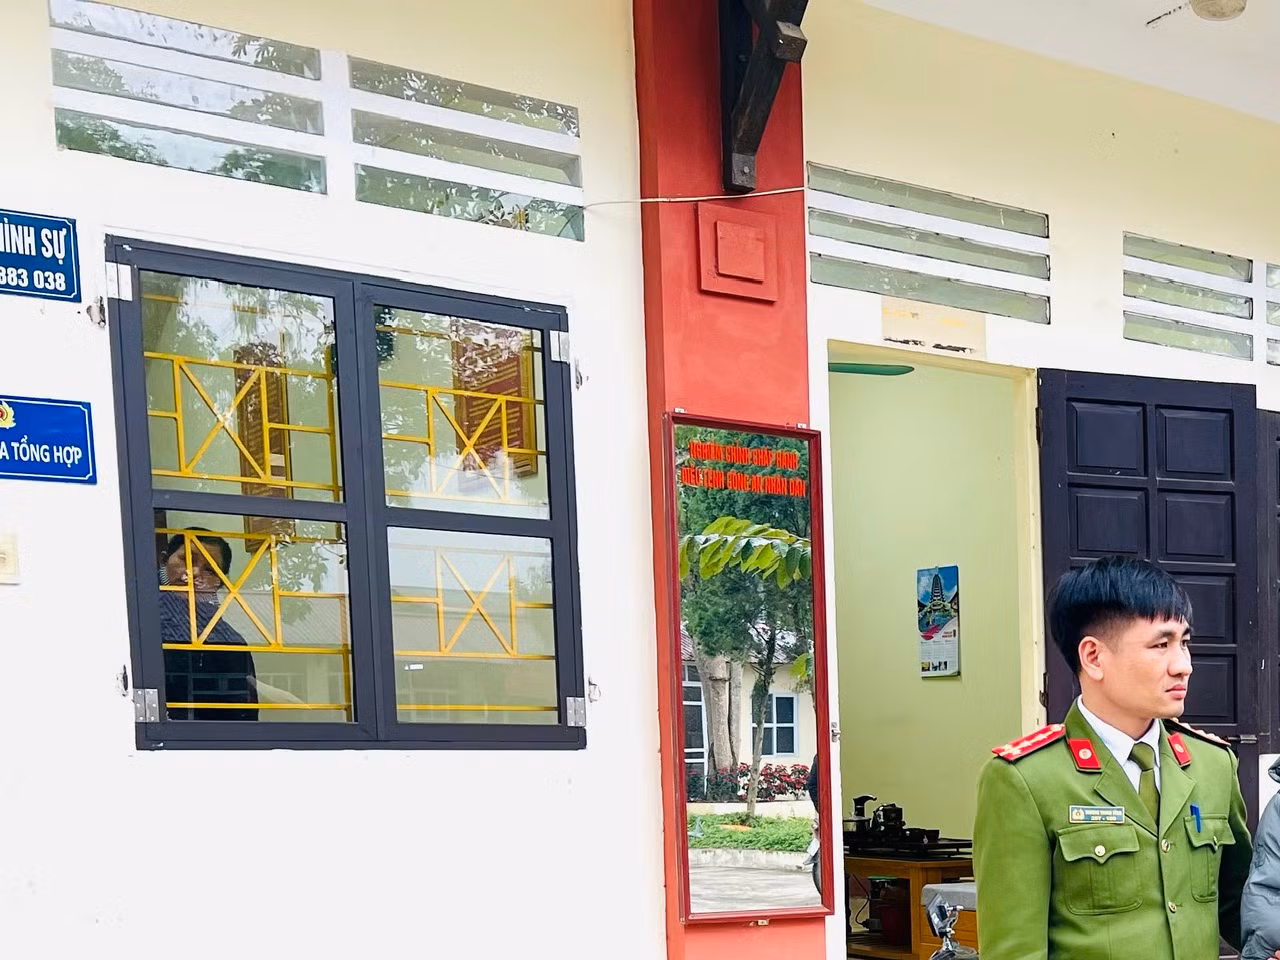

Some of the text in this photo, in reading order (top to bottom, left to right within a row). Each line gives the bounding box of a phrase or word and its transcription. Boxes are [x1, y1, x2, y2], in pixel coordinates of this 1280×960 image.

[41, 228, 67, 265] SỰ
[33, 270, 66, 291] 038
[11, 435, 50, 462] TỔNG
[53, 445, 82, 468] HỢP
